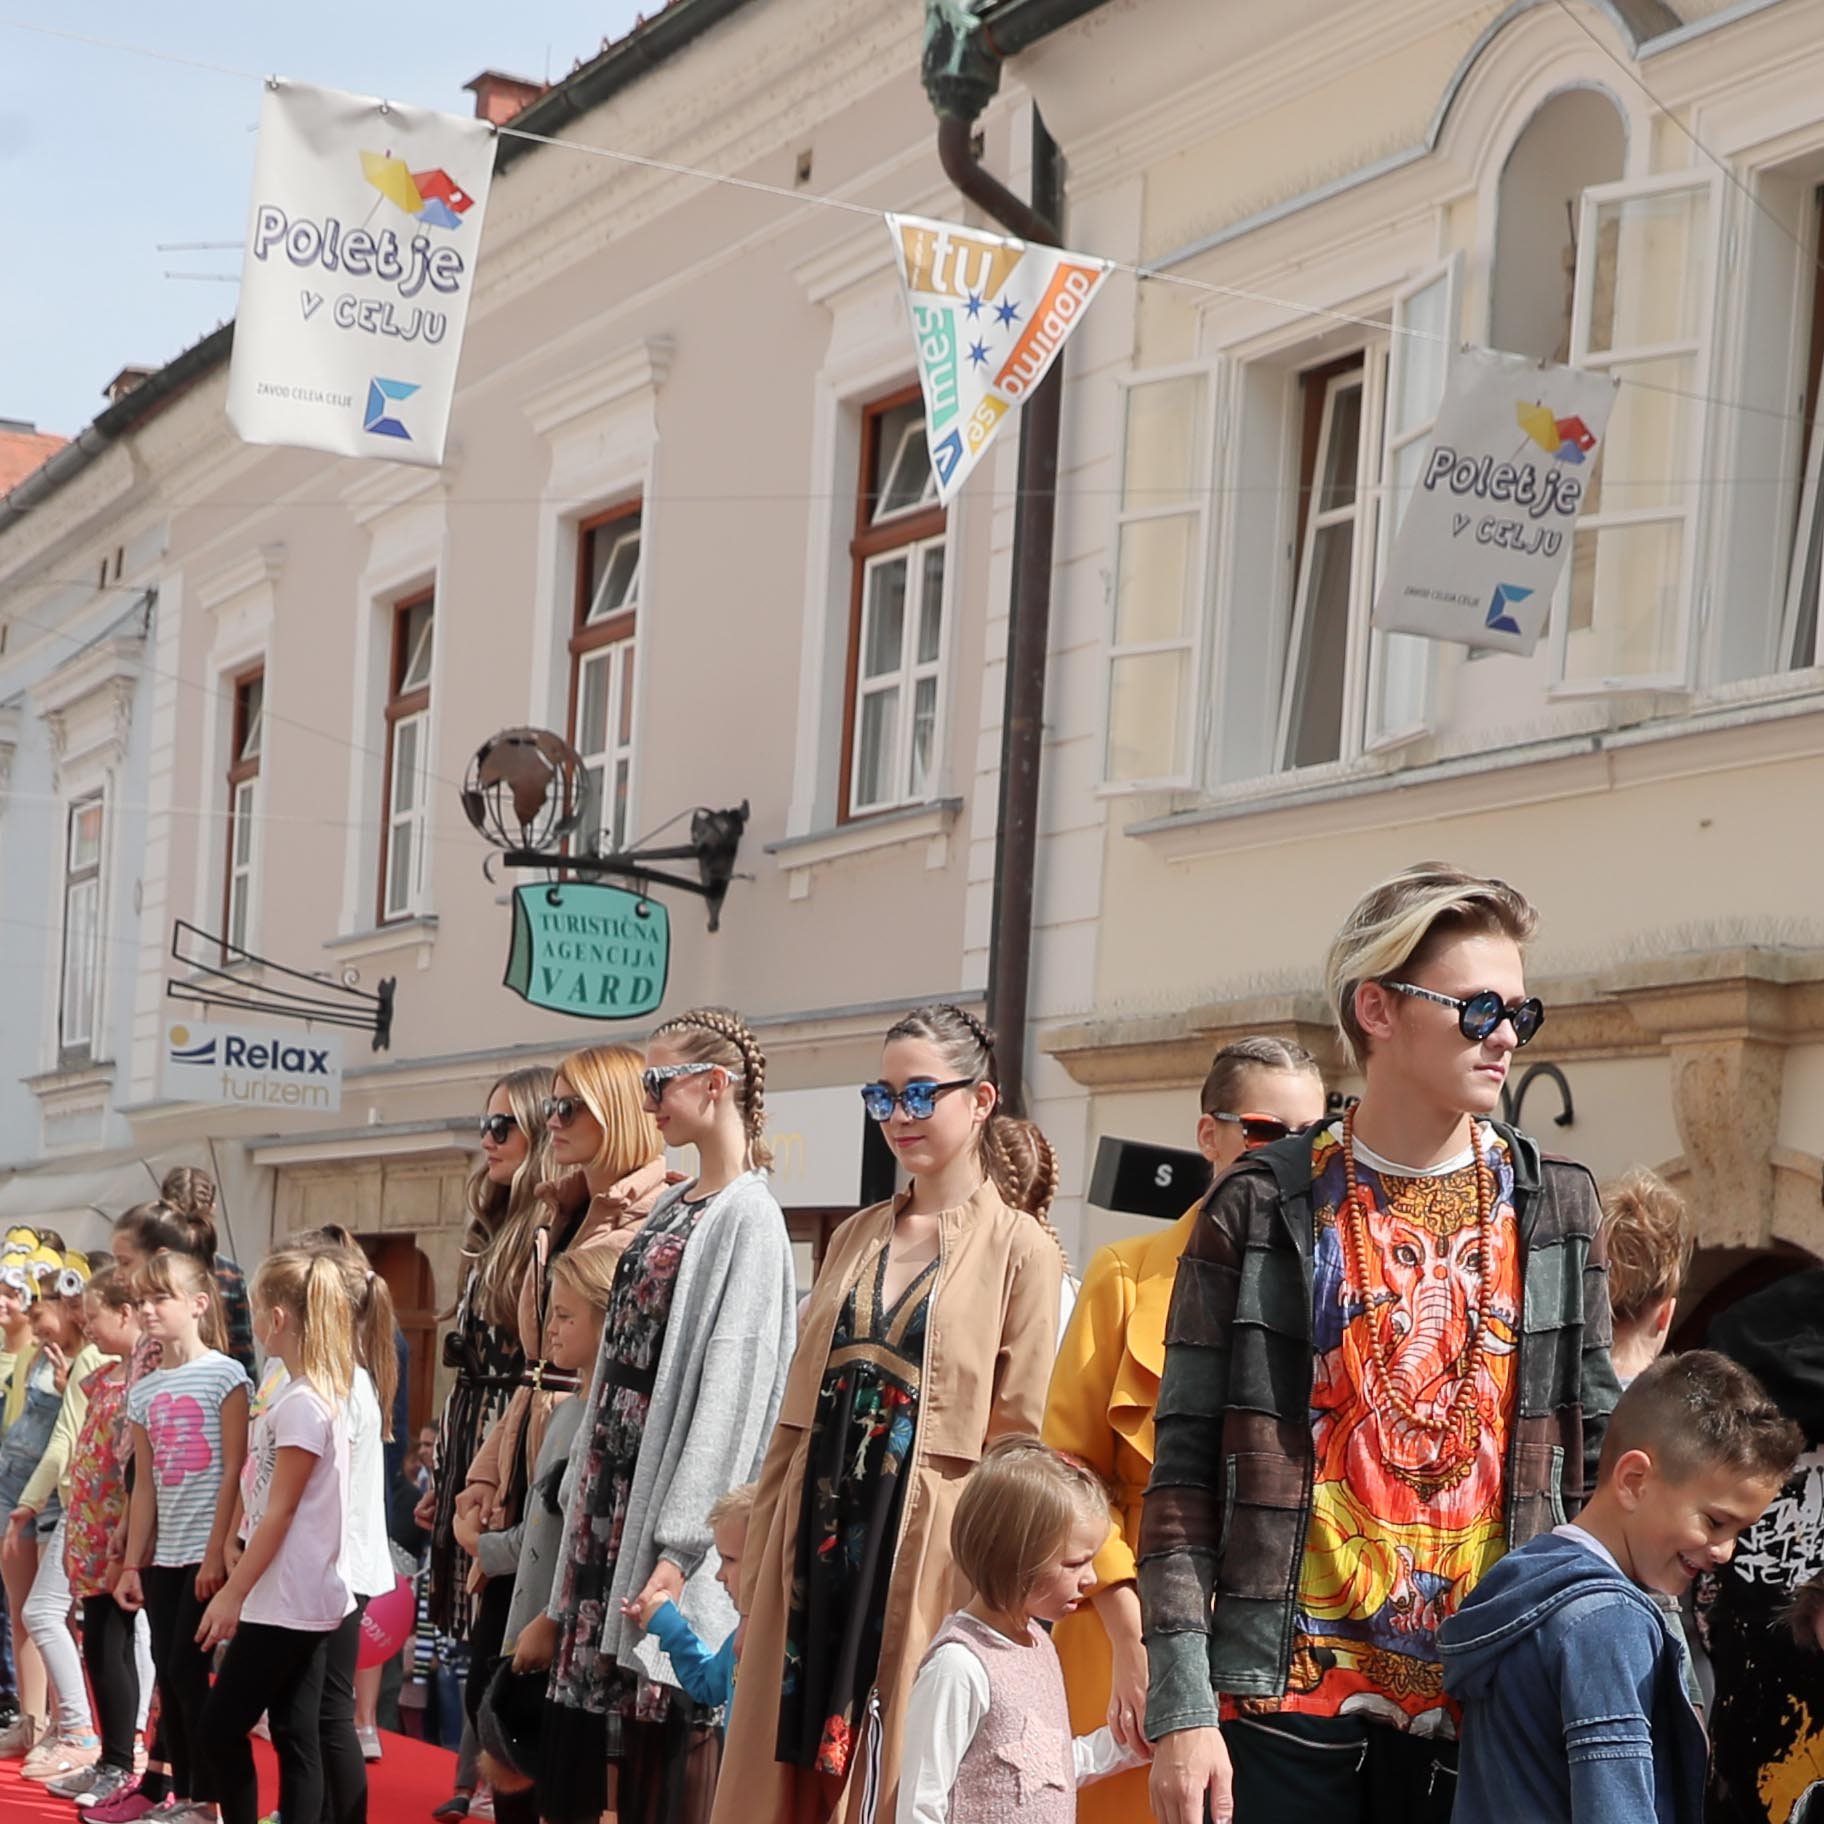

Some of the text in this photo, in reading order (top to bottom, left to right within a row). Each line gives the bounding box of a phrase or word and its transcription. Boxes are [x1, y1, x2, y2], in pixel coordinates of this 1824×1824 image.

[253, 204, 465, 298] Poletje
[333, 292, 448, 344] CELJU
[256, 381, 353, 409] ZAVOD CELEIA CELJE
[1424, 446, 1583, 519] Poletje
[1477, 515, 1563, 557] CELJU
[541, 912, 659, 943] TURISTIČNA
[543, 940, 656, 968] AGENCIJA
[541, 965, 654, 1006] VARD
[224, 1035, 329, 1075] Relax
[221, 1073, 330, 1106] turizem
